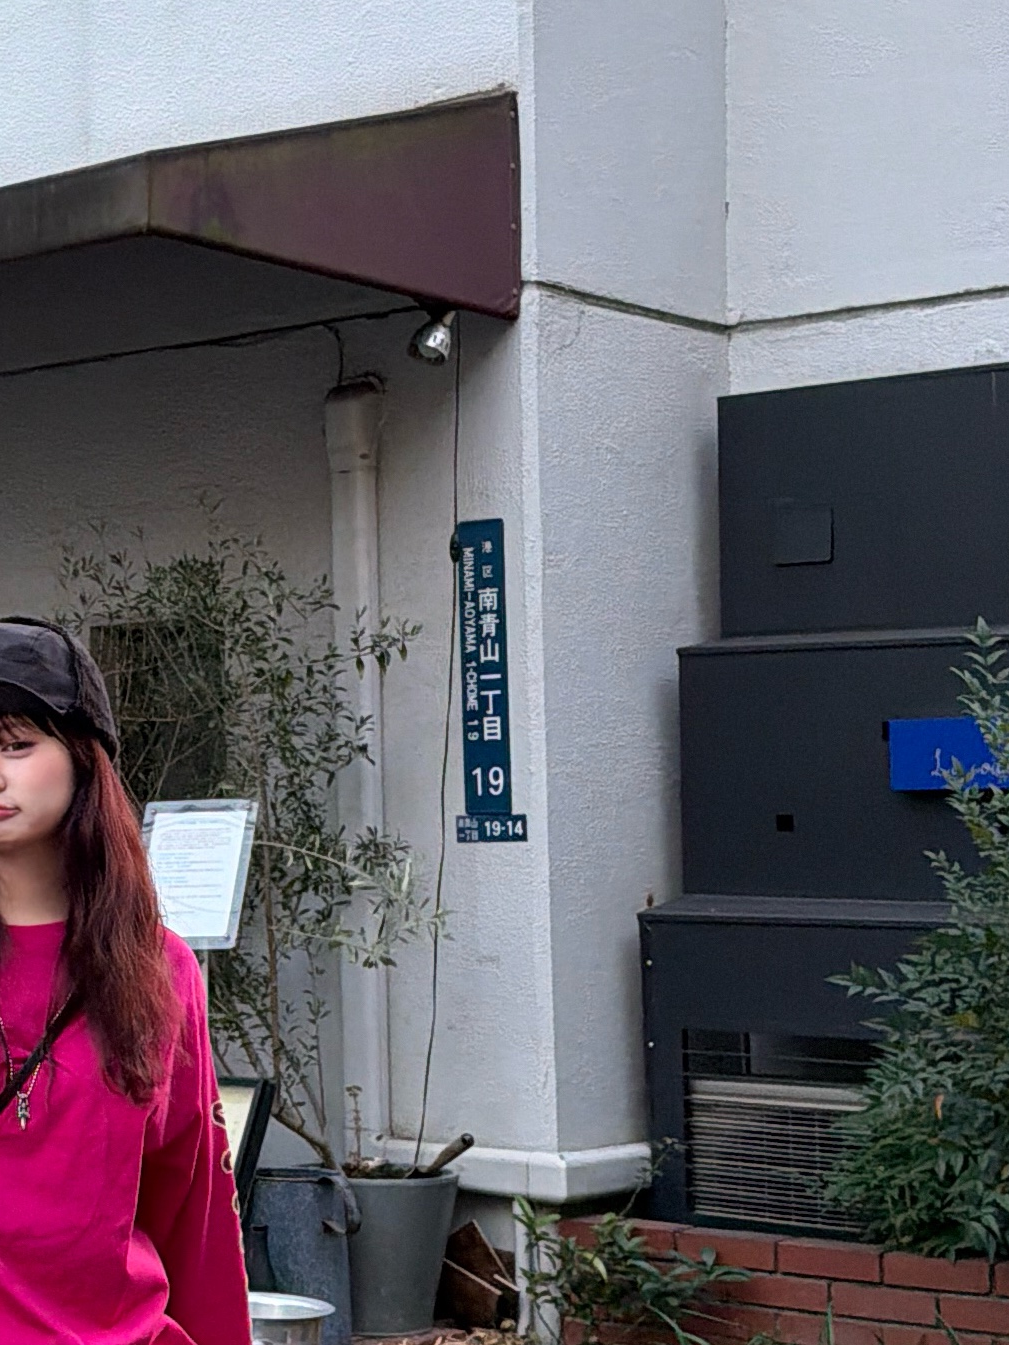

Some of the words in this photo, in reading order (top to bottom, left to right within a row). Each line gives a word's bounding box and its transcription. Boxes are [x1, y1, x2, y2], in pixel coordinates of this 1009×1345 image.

[462, 546, 477, 653] MINAMI-AOYAMA
[466, 661, 479, 711] 1-CHOME
[477, 586, 502, 741] 南青山一丁目
[471, 766, 504, 796] 19
[484, 820, 524, 837] 19-14
